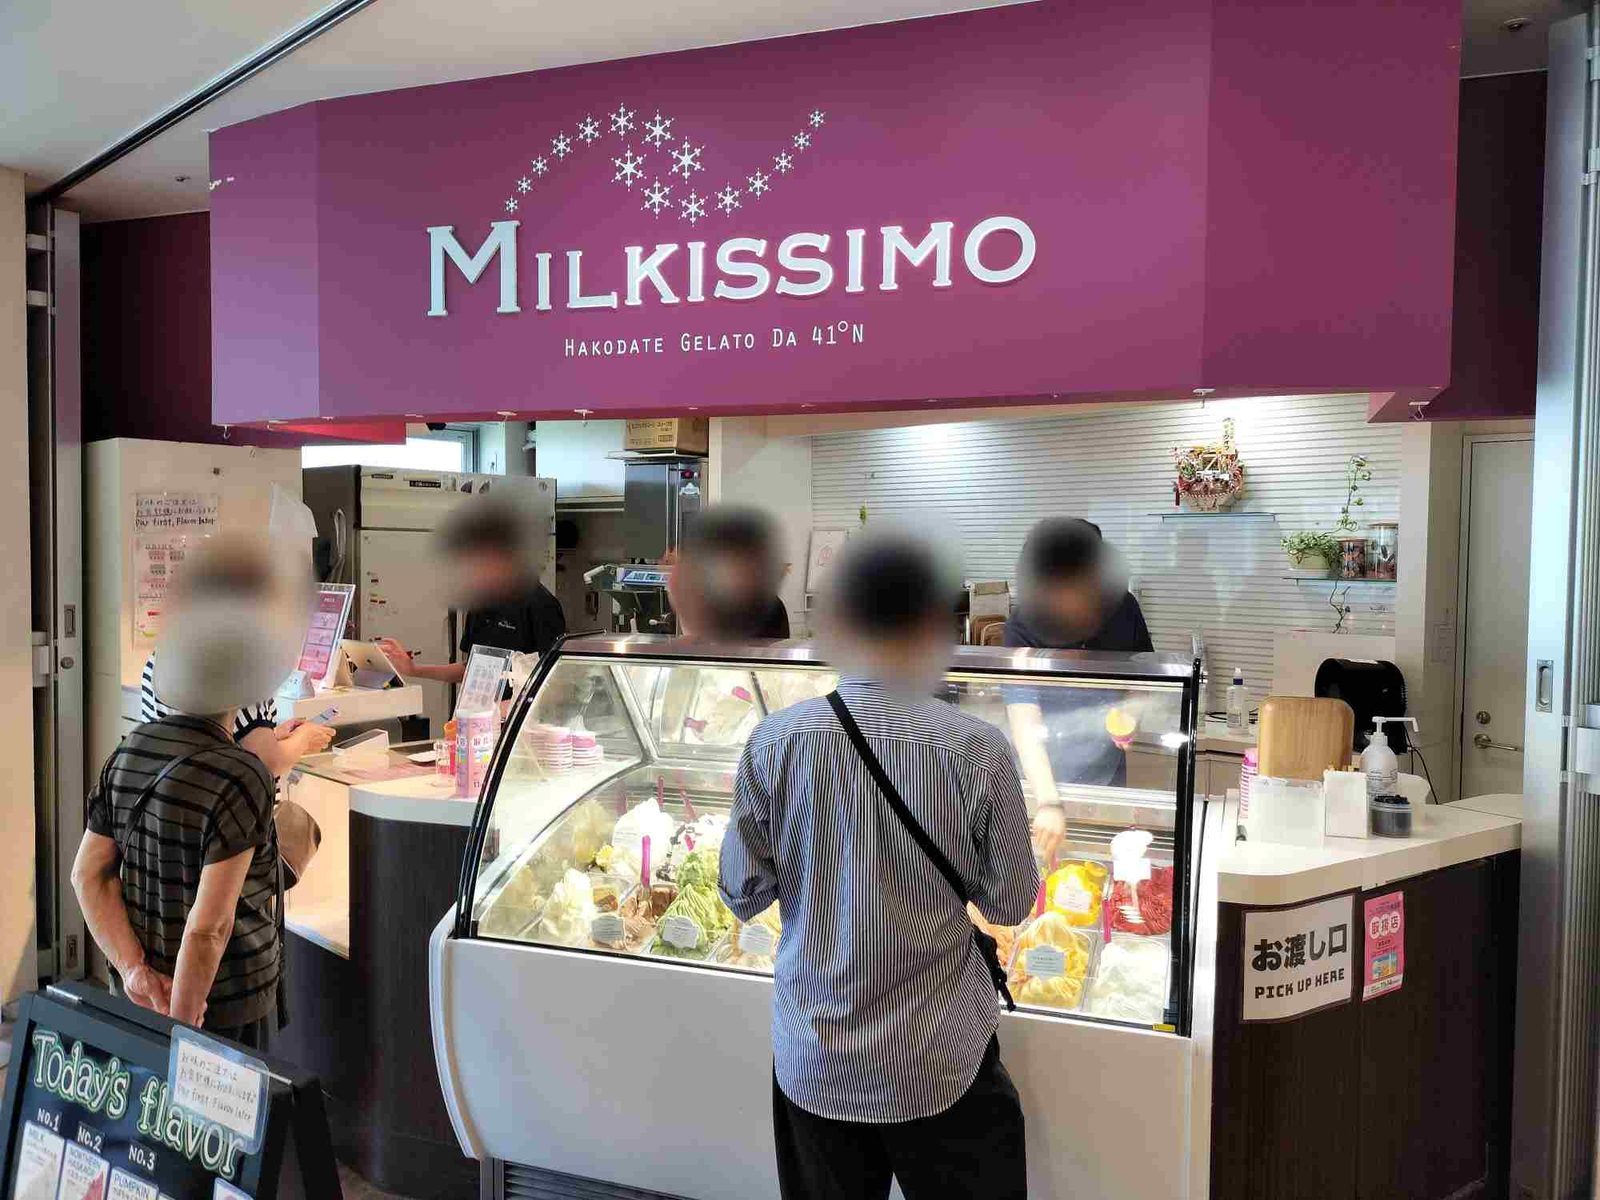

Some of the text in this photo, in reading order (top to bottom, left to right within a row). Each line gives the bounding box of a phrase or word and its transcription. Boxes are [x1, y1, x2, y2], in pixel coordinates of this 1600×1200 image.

[565, 338, 664, 357] HAKODATE
[680, 332, 755, 352] GELATO
[772, 328, 797, 348] DA
[1251, 923, 1348, 972] お渡し口
[1254, 967, 1345, 999] PICK UP HERE
[33, 1030, 244, 1177] Today's flavor
